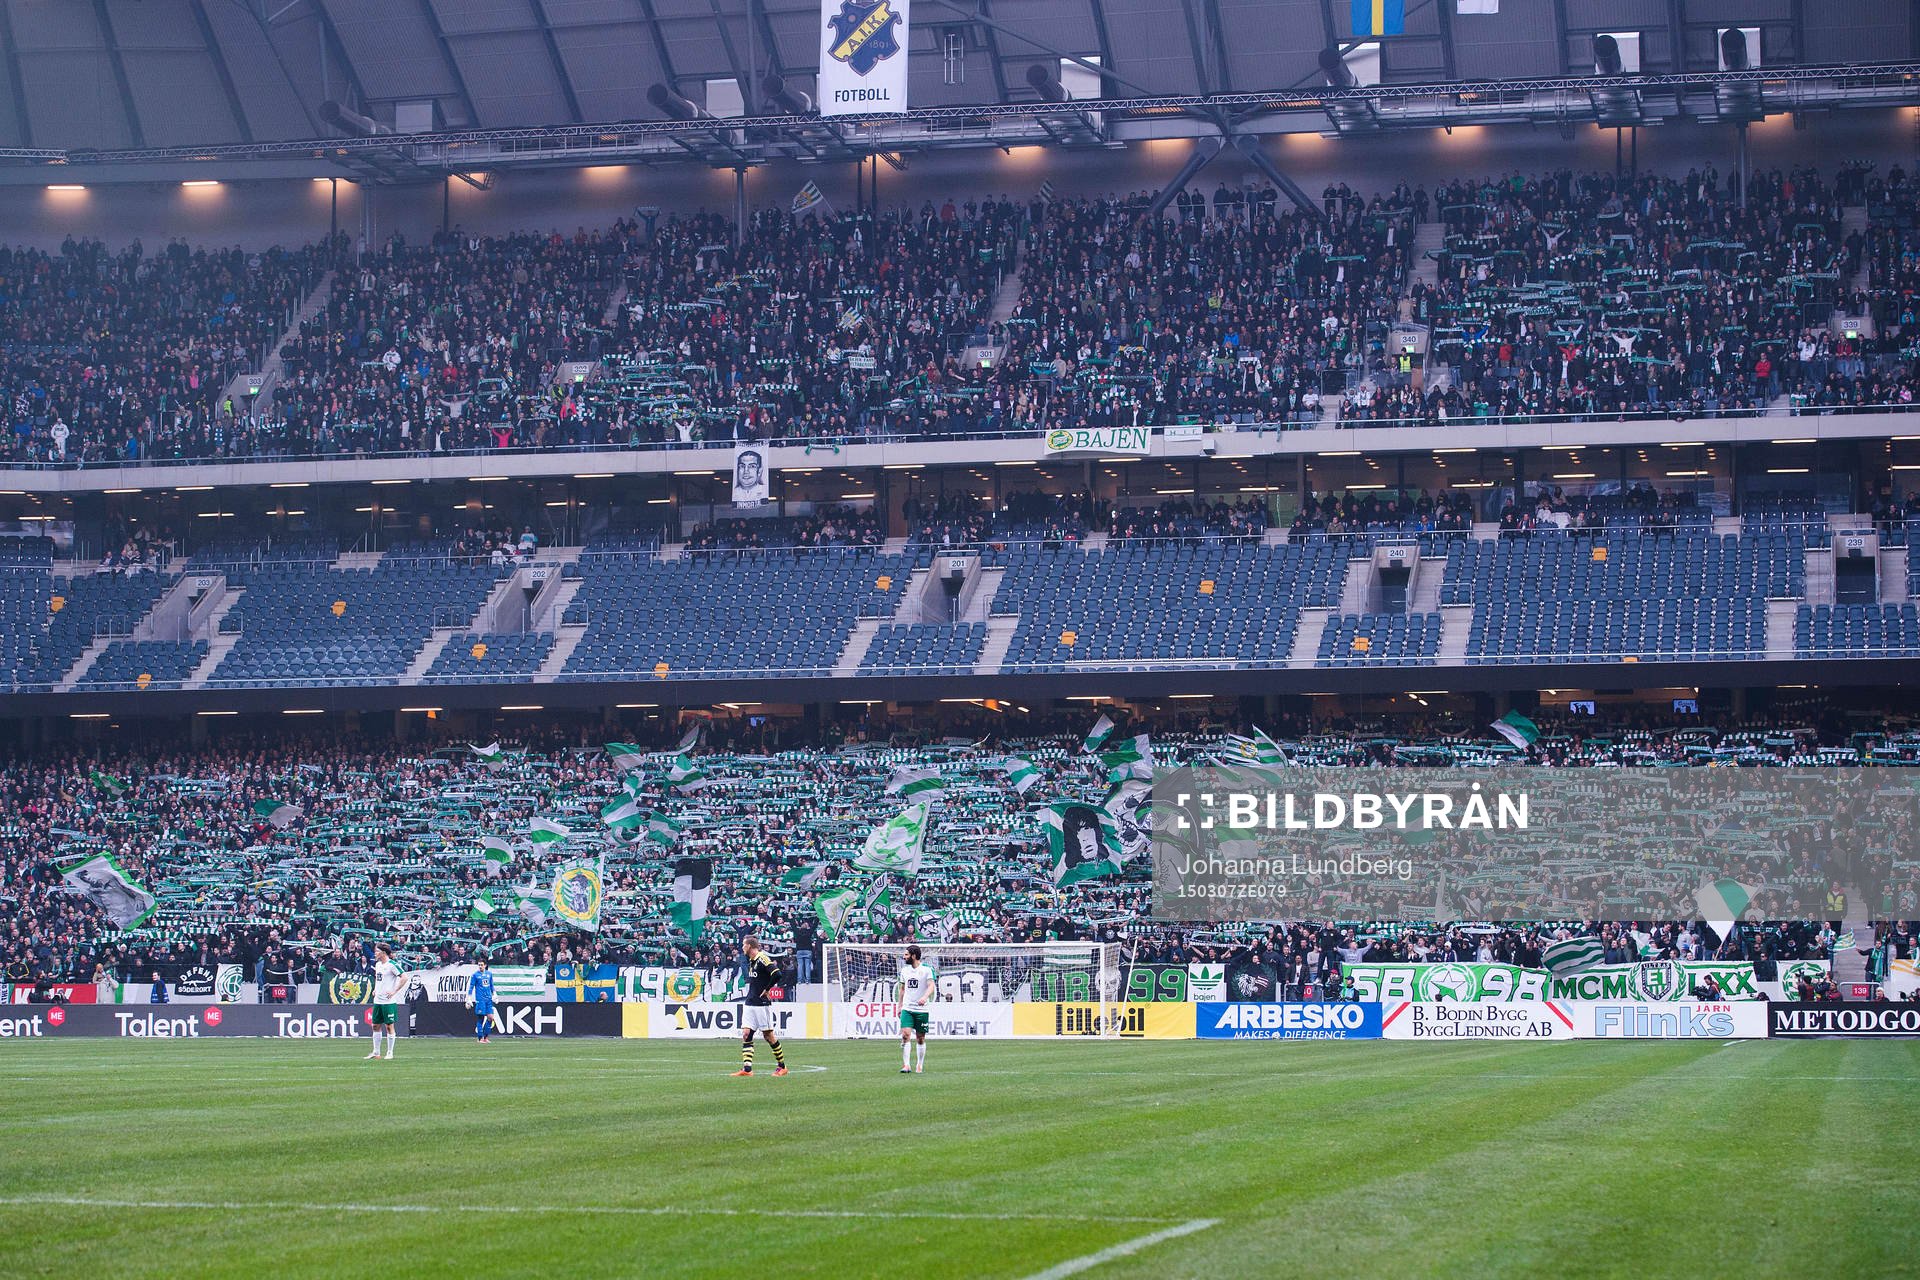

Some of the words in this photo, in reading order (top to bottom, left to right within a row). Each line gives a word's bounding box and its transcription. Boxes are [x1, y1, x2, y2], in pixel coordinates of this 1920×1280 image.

[835, 88, 890, 103] FOTBOLL
[1402, 335, 1417, 343] 340
[1074, 428, 1149, 449] BAJEN
[1390, 549, 1404, 557] 240
[532, 570, 546, 578] 202
[179, 966, 214, 982] DEFEND
[274, 988, 286, 996] 102
[1128, 968, 1188, 1002] 99
[1552, 974, 1627, 1000] MCM
[1193, 992, 1216, 1002] bajen
[50, 1012, 63, 1020] ME
[207, 1012, 219, 1020] ME
[1214, 1004, 1364, 1029] ARBESKO
[1413, 1006, 1429, 1020] B.
[114, 1012, 199, 1037] Talent
[273, 1012, 359, 1037] Talent
[1595, 1006, 1735, 1037] Flinks
[1233, 1030, 1270, 1040] MAKES
[1284, 1030, 1346, 1040] DIFFERENCE
[1526, 1022, 1552, 1037] AB
